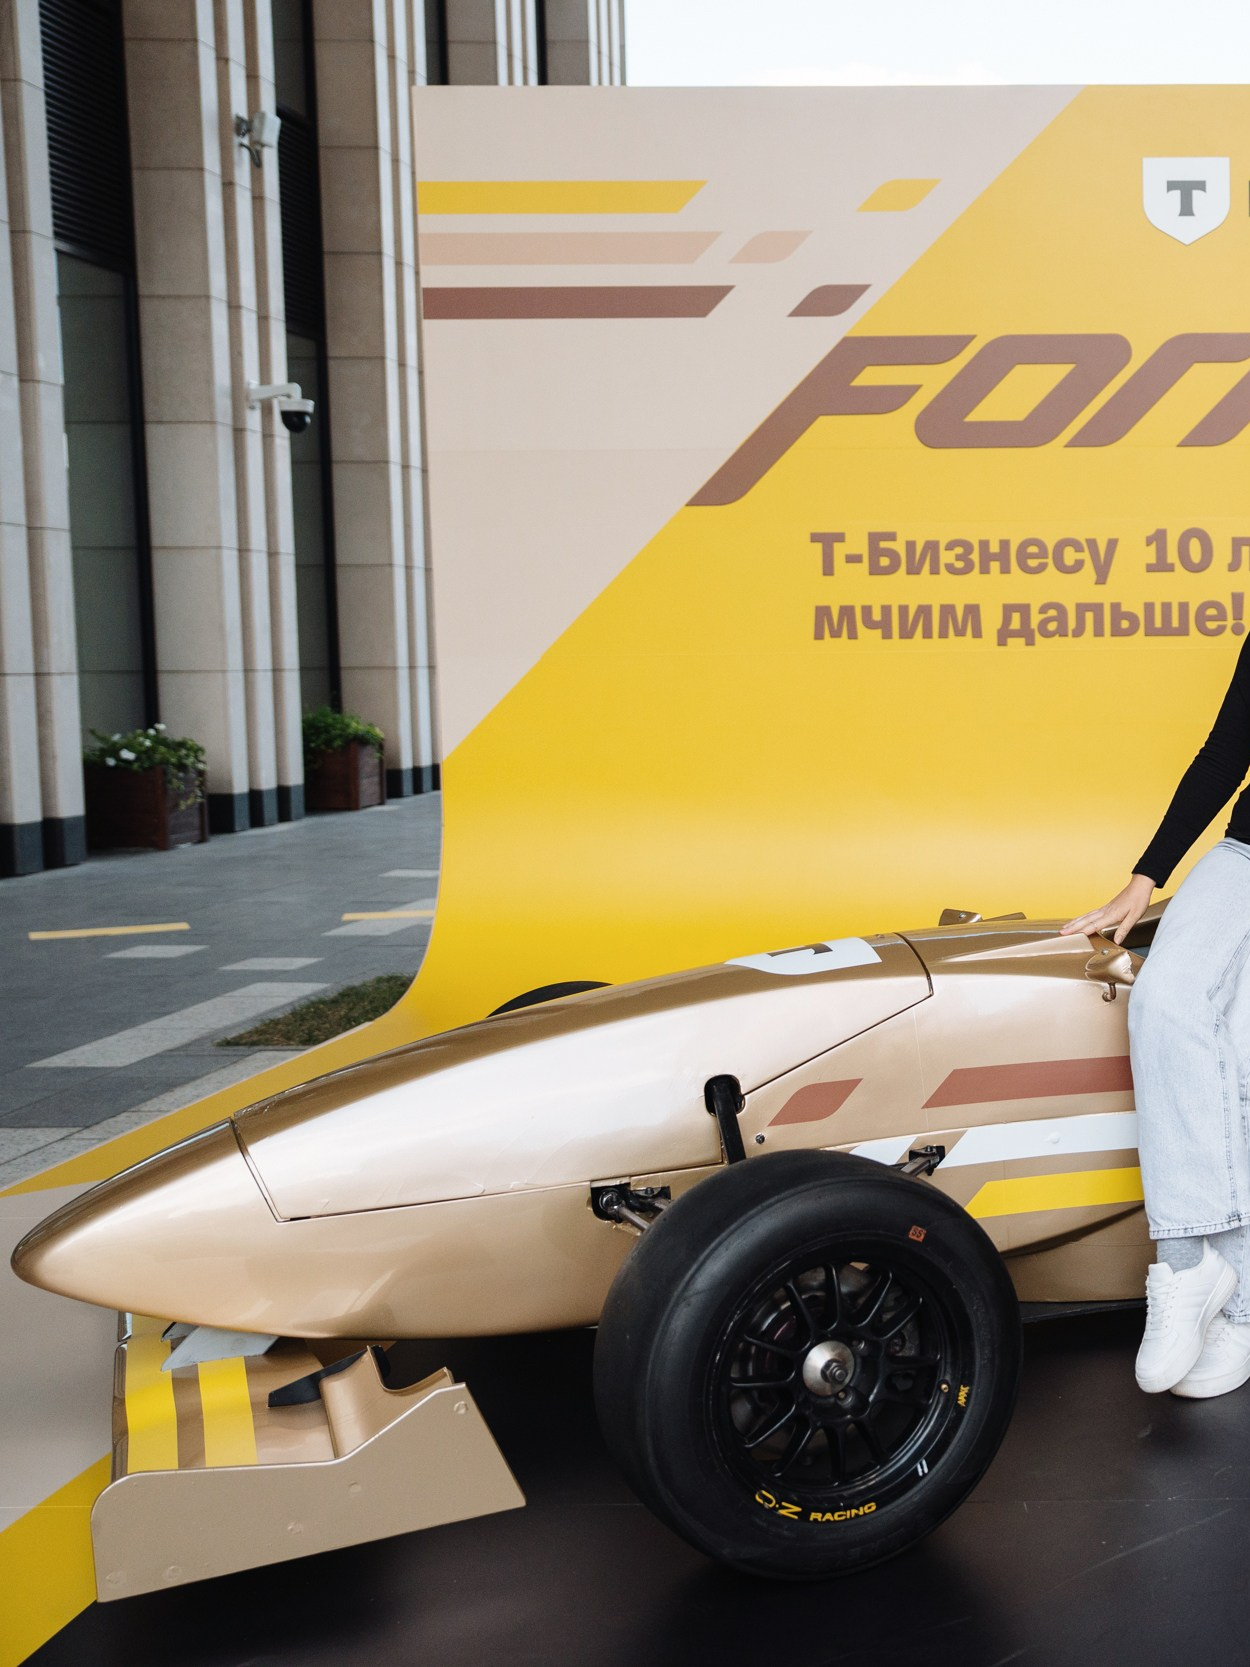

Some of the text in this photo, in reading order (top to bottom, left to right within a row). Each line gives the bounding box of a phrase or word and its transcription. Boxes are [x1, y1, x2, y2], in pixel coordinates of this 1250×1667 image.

[1166, 180, 1207, 217] Т
[809, 531, 1120, 586] Т-Бизнесу
[1145, 527, 1214, 574] 10
[813, 591, 1246, 647] мчим дальше!
[809, 1501, 877, 1521] RACING
